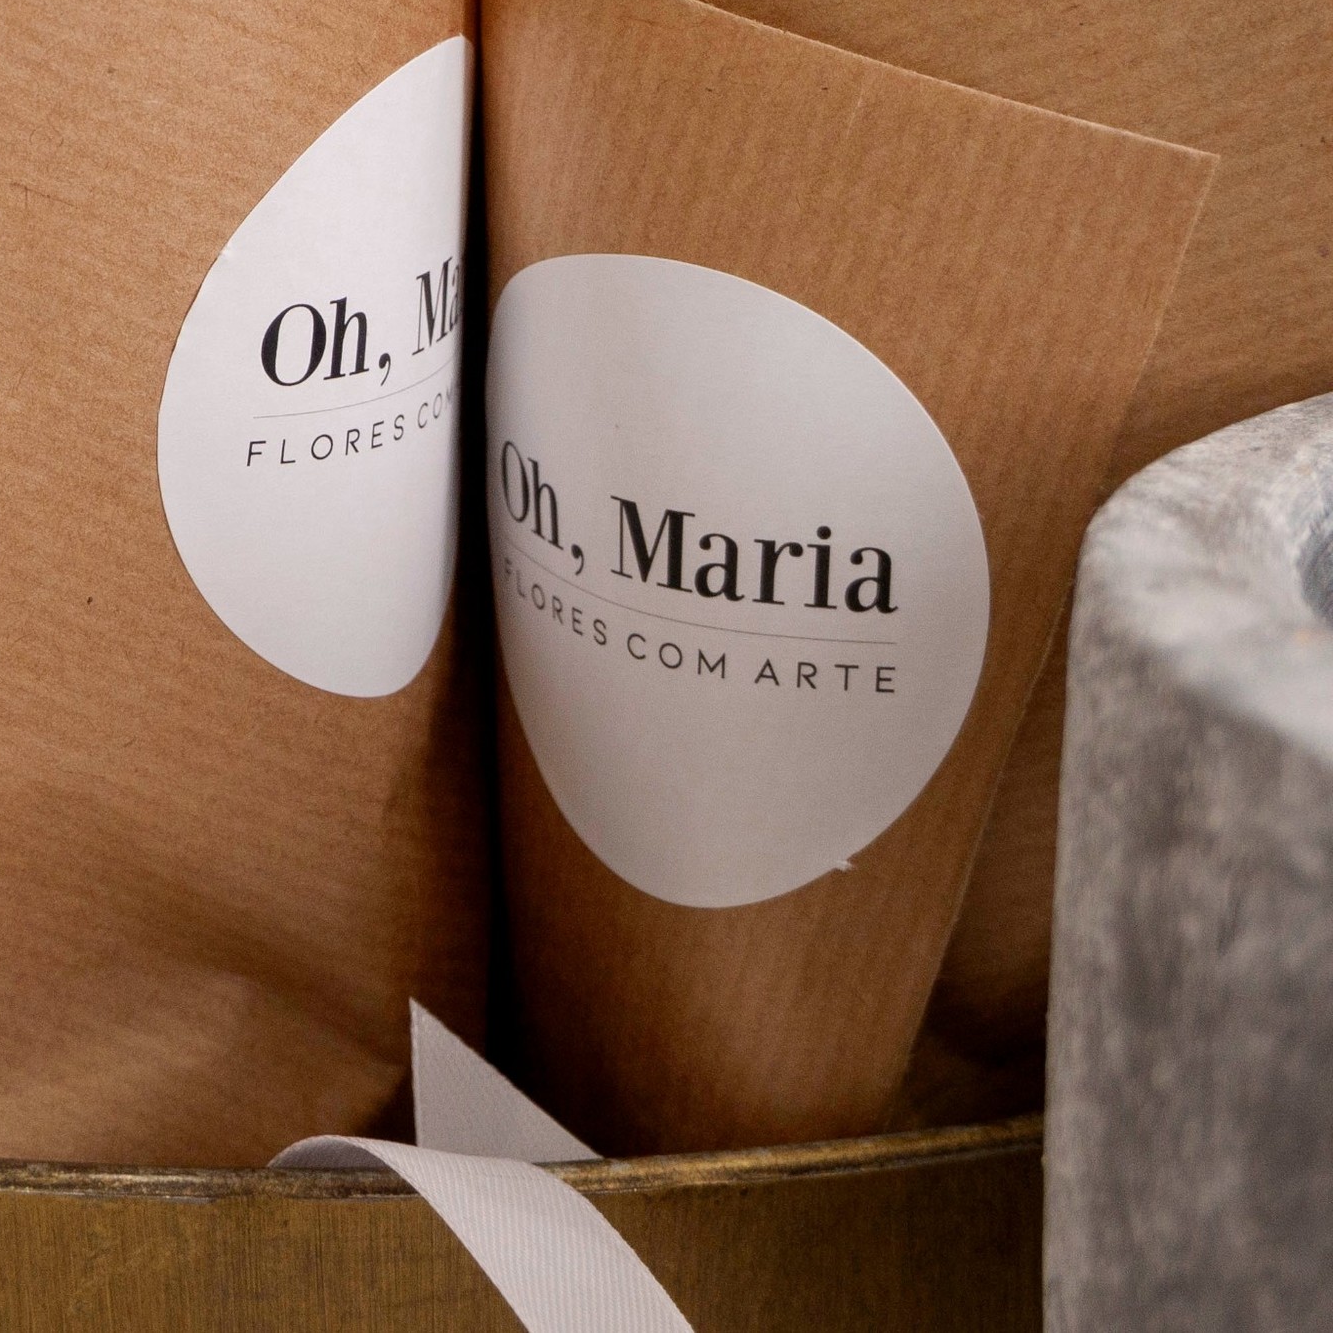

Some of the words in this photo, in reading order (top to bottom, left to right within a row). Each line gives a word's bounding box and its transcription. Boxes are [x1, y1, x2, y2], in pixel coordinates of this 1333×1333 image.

[260, 296, 392, 387] Oh,
[246, 414, 405, 468] FLORES
[501, 440, 585, 576] Oh,
[609, 494, 899, 615] Maria
[626, 632, 727, 679] COM
[753, 658, 897, 694] ARTE
